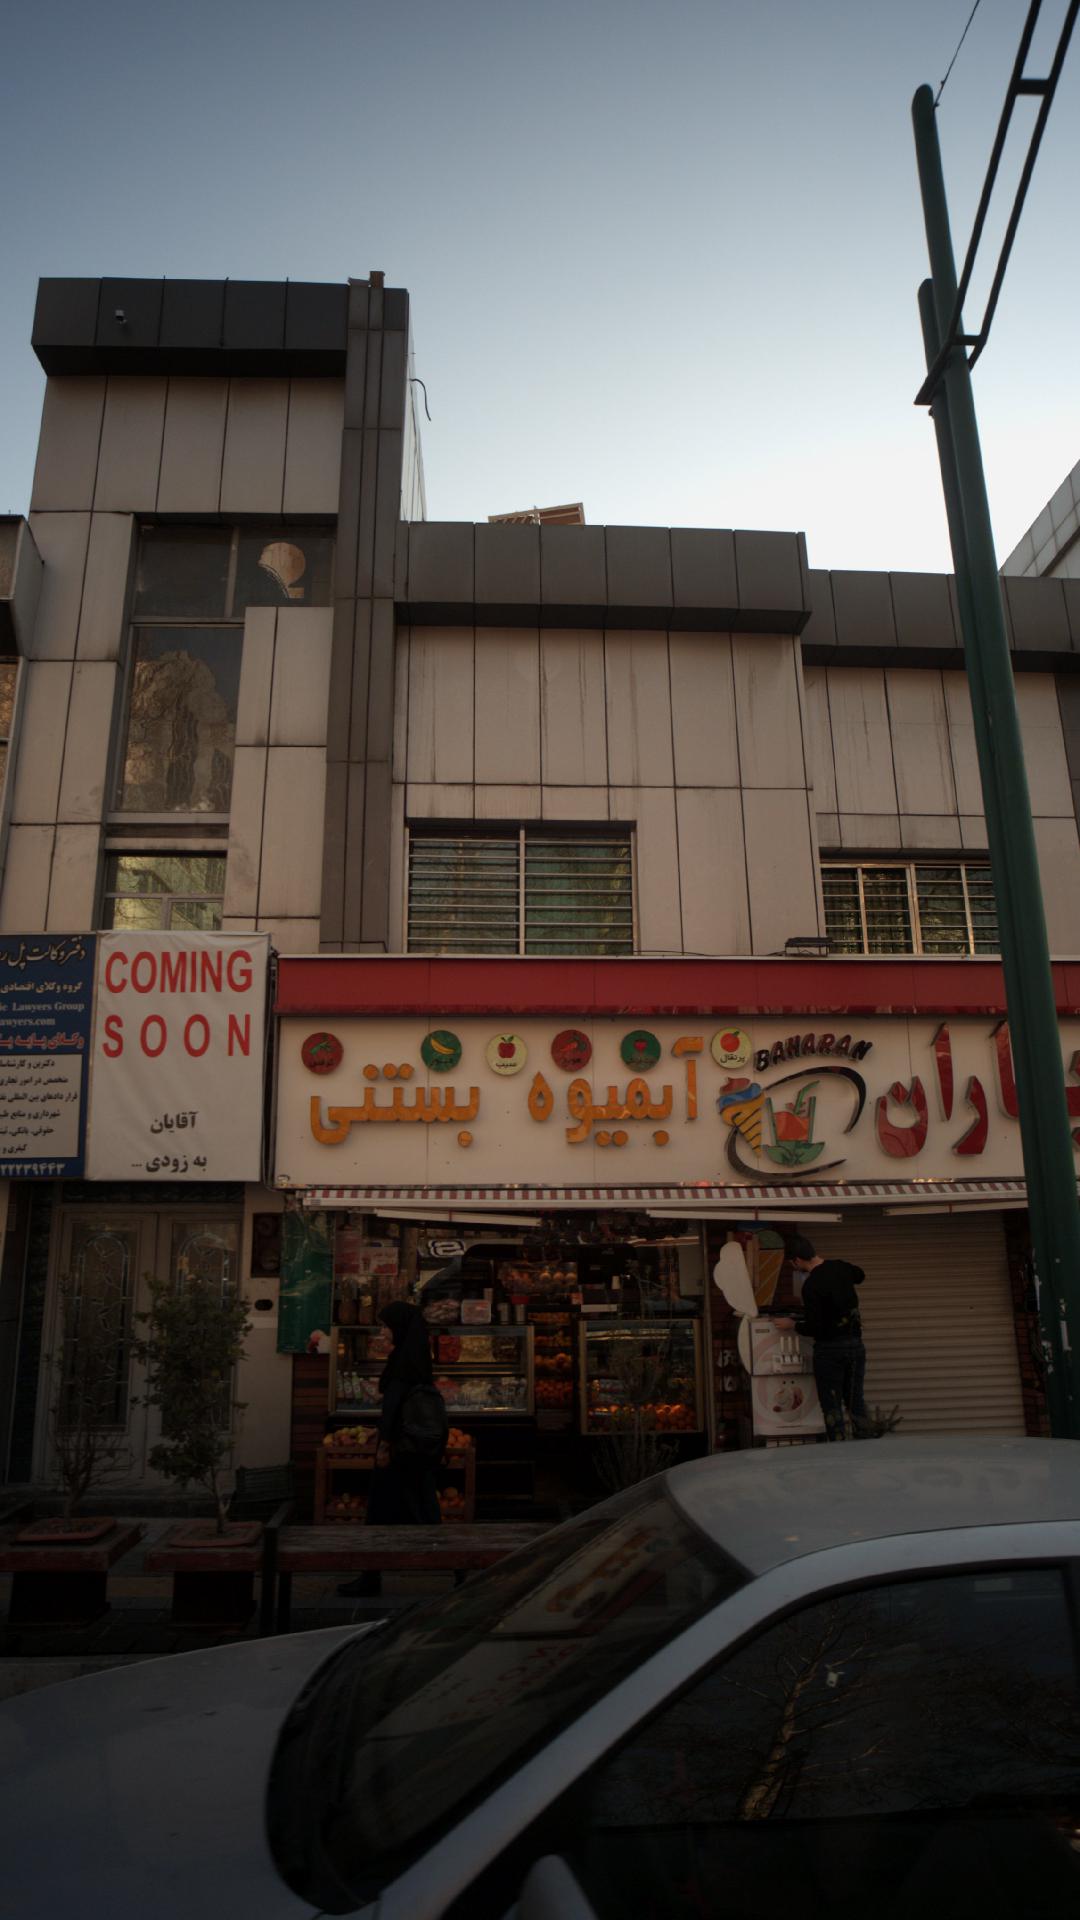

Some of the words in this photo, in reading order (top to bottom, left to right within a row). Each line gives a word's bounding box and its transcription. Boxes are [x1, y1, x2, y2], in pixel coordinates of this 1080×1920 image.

[104, 949, 253, 994] COMING
[0, 1018, 56, 1027] awyers.com
[12, 1002, 52, 1013] Lawyers
[54, 1002, 85, 1012] Group
[102, 1013, 251, 1058] SOON
[753, 1032, 873, 1073] BAHARAN
[310, 1063, 481, 1148] بستنی
[150, 1111, 199, 1134] آقایان
[193, 1156, 208, 1172] به
